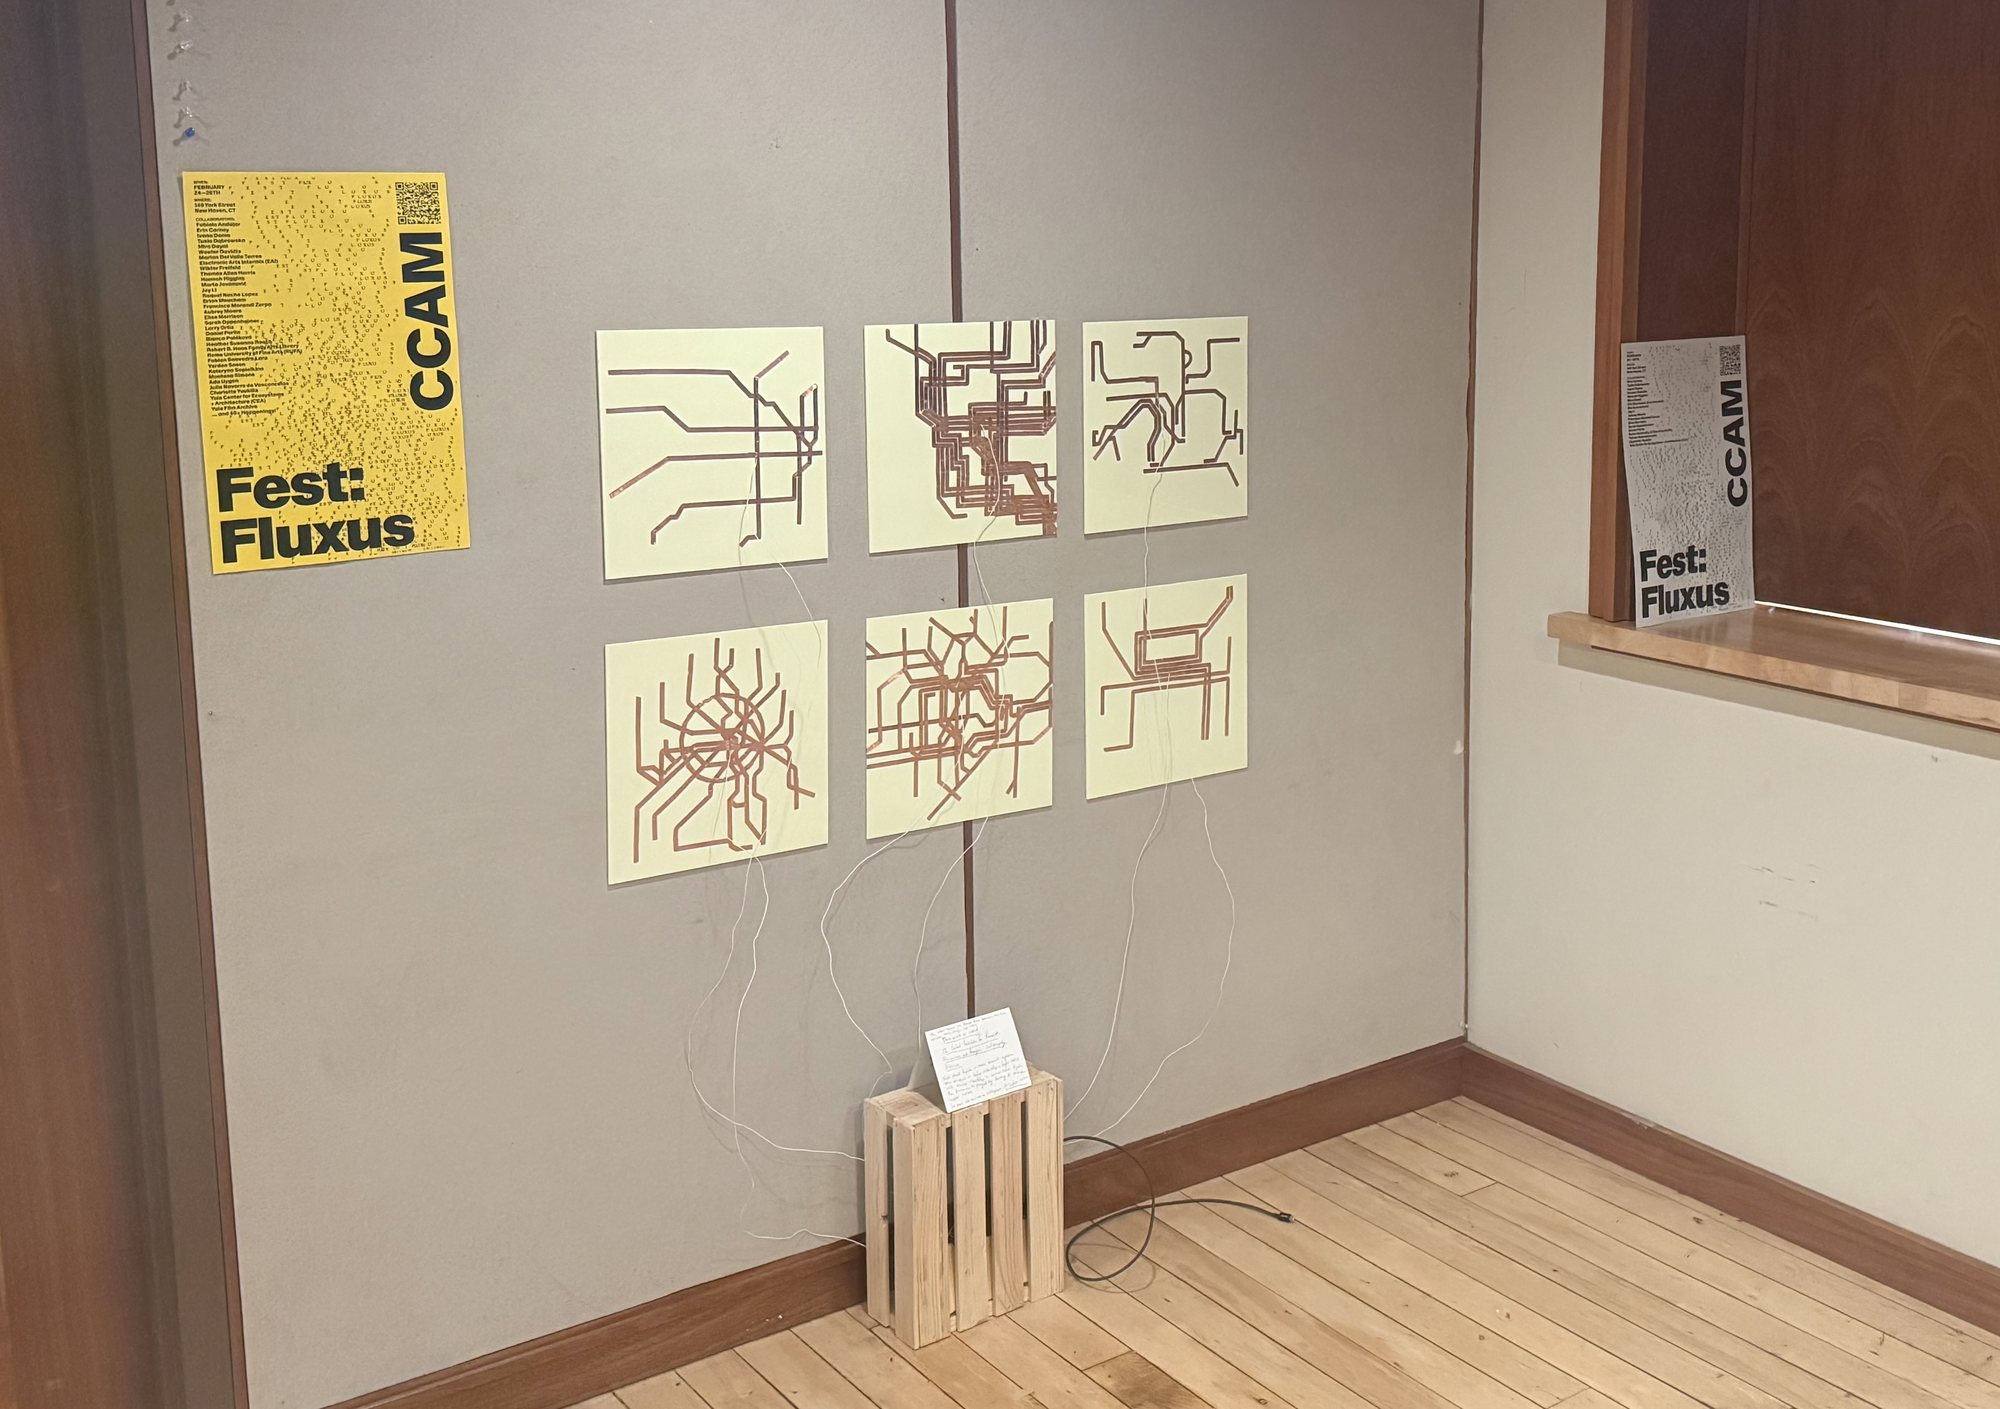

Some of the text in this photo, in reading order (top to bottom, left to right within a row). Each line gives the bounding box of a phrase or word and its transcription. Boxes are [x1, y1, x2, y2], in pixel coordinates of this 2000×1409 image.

[402, 232, 454, 411] CCAM
[1720, 380, 1748, 507] CCAM
[216, 462, 366, 512] Fest:
[220, 514, 416, 564] Fluxus
[1640, 545, 1707, 582] Fest:
[1642, 582, 1730, 618] Fluxus
